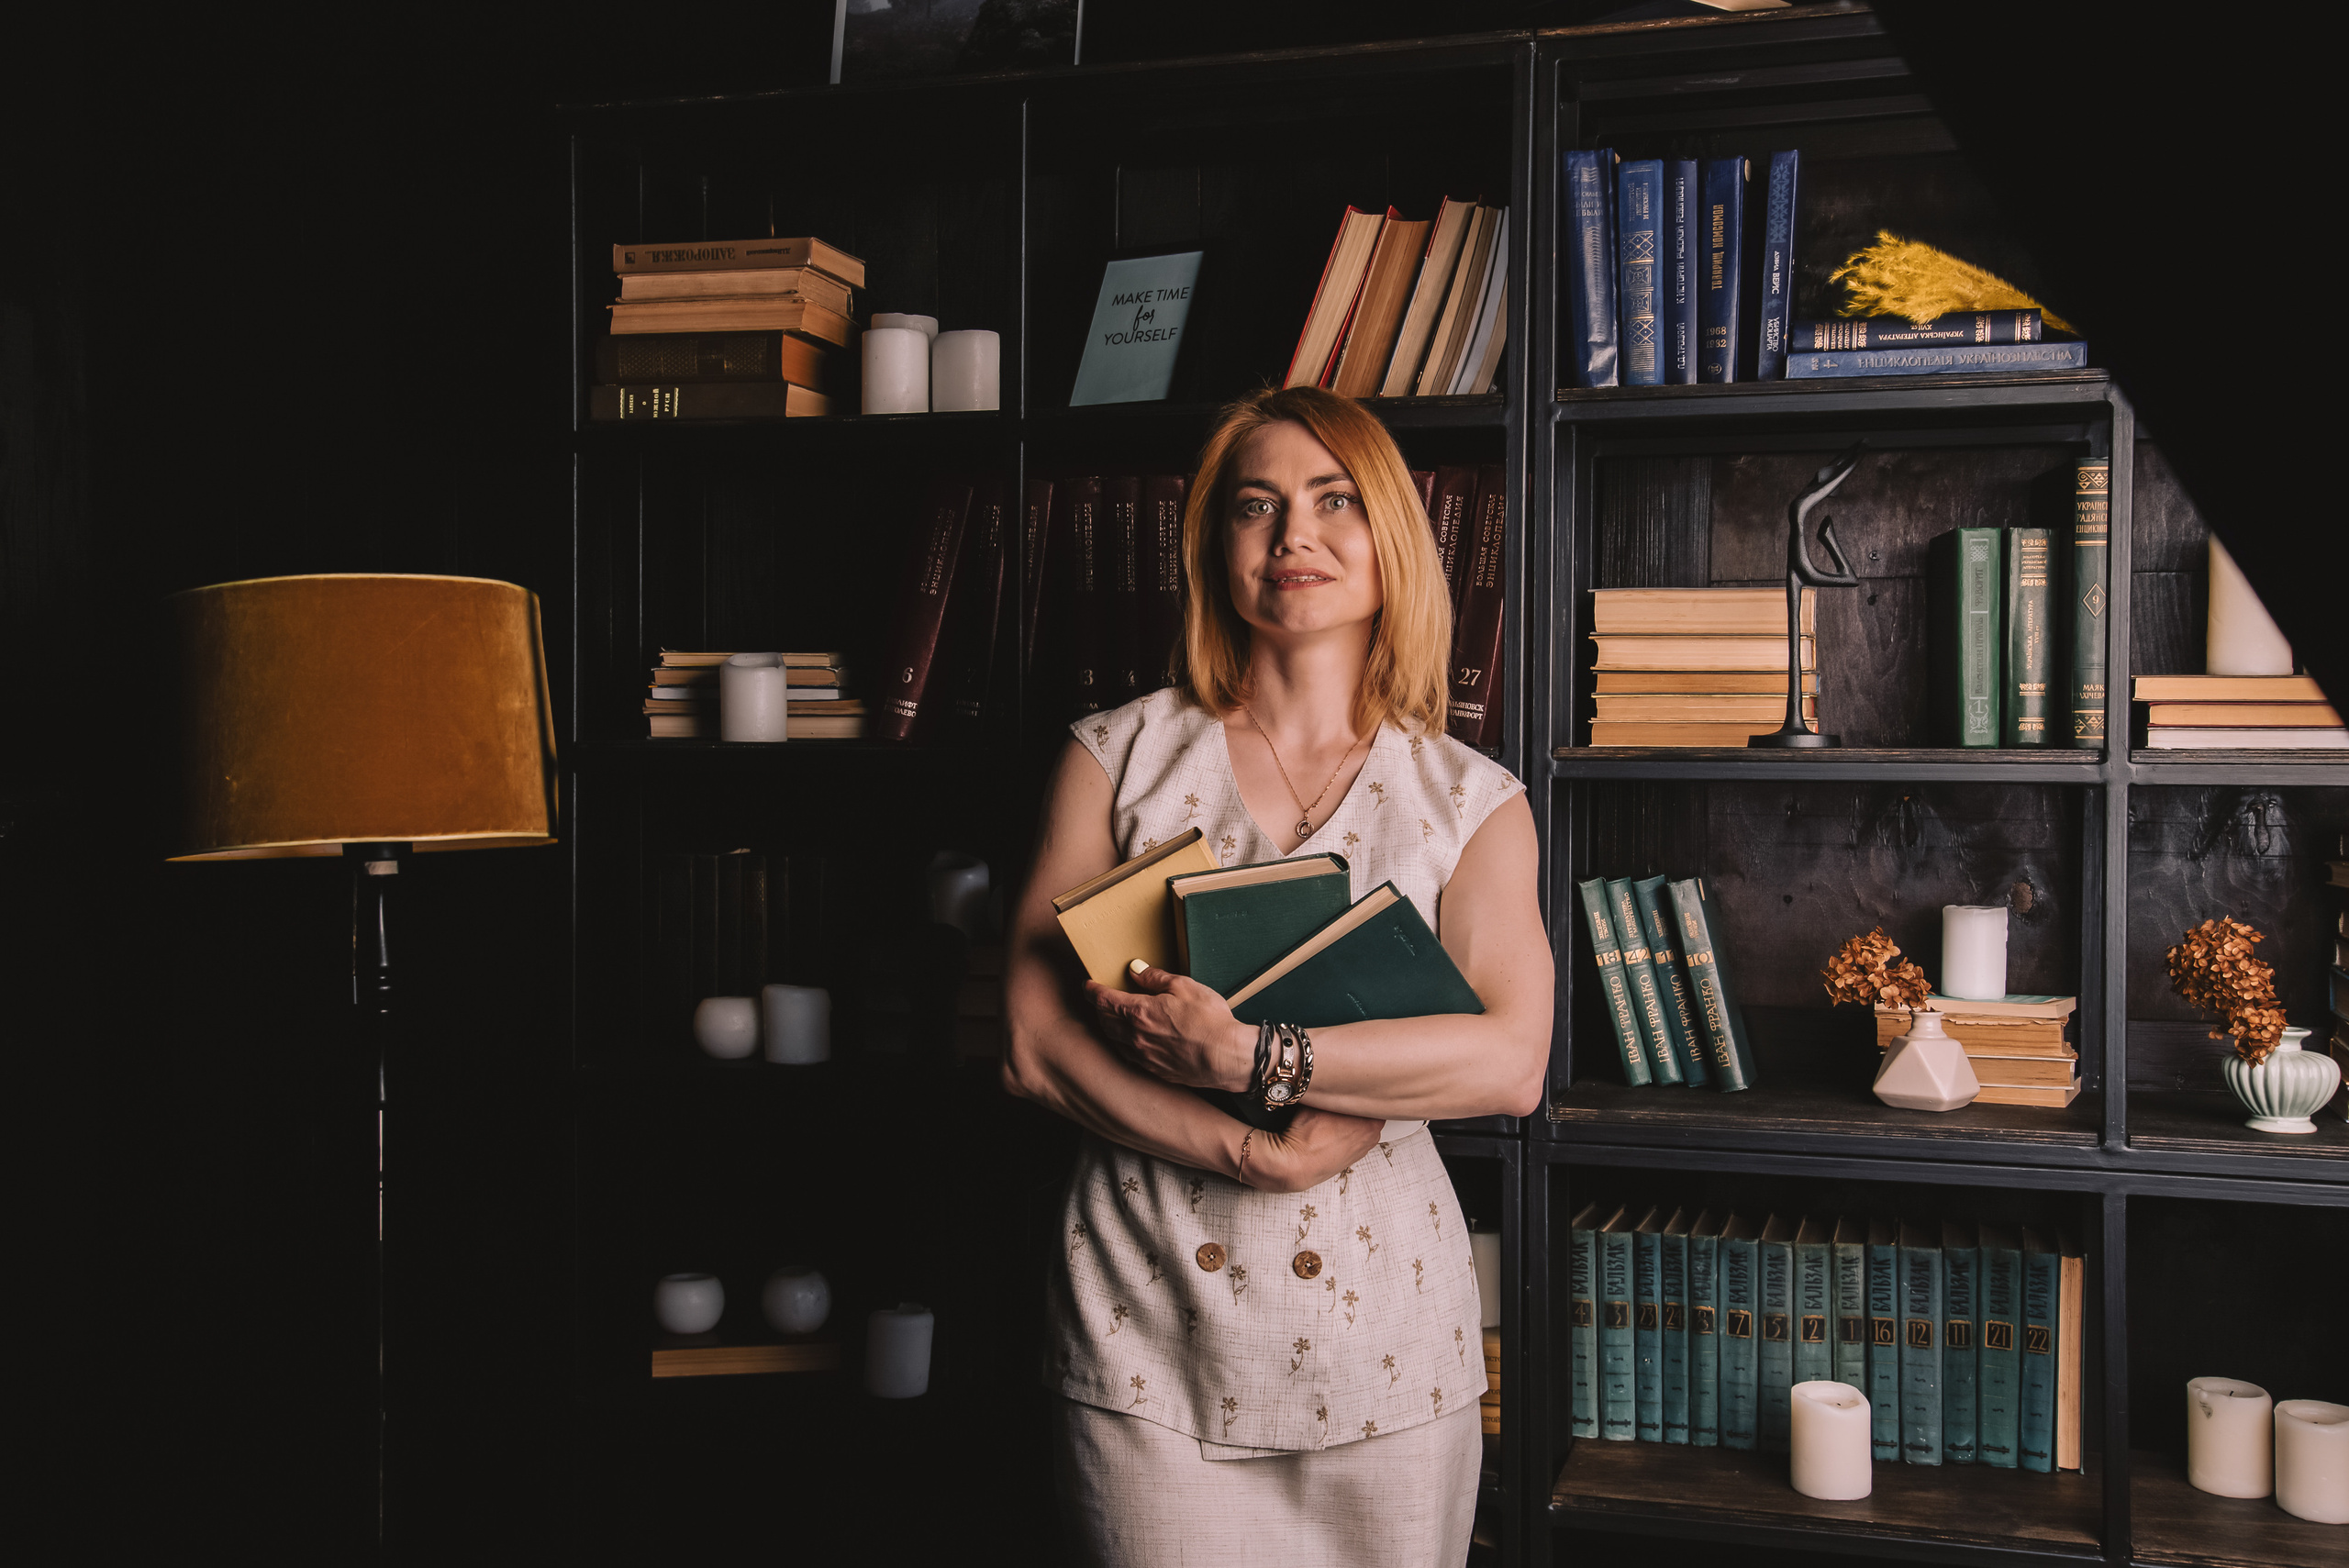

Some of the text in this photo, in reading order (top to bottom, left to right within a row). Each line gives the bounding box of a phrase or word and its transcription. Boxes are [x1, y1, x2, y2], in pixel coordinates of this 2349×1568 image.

[1675, 176, 1686, 223] РЕВОЛЮЦИИ
[1675, 226, 1686, 260] РУССКОЙ
[1710, 203, 1725, 291] ТОВАРИЩ КОМСОМОЛ
[1111, 286, 1190, 306] MAKE TIME
[1675, 261, 1686, 296] ИСТОРИИ
[1132, 305, 1156, 331] for
[1706, 326, 1727, 336] 1968
[1772, 317, 1780, 352] УБИЙСТВО
[1104, 327, 1178, 346] YOURSELF
[1823, 359, 1839, 369] 4
[1858, 350, 2074, 370] ЕНЦИКЛОПЕДІЯ УКРАЇНОЗНАВСТВА
[1439, 494, 1454, 544] СОВЕТСКАЯ
[929, 508, 956, 595] ЭНЦИКЛОПЕДИЯ
[1083, 502, 1094, 593] ЭНЦИКЛОПЕДИЯ
[1168, 499, 1178, 592] ЭНЦИКЛОПЕДИЯ
[1475, 493, 1497, 587] БОЛЬШАЯ СОВЕТСКАЯ
[1974, 567, 1984, 606] ФАВОРИТ
[2092, 594, 2099, 606] 9
[901, 666, 915, 684] 6
[1458, 666, 1482, 686] 27
[1450, 700, 1485, 712] ЛЬЯНОВСК
[1597, 950, 1619, 966] 18
[1627, 948, 1650, 963] 42
[1657, 950, 1675, 964] 11
[1687, 951, 1712, 967] 10
[1609, 975, 1642, 1065] ІВАН ФРАНКО
[1639, 973, 1671, 1063] ІВАН ФРАНКО
[1669, 973, 1703, 1064] ІВАН ФРАНКО
[1699, 978, 1731, 1069] ІВАН ФРАНКО
[1571, 1241, 1588, 1295] БАЛЬЗАК
[1607, 1242, 1625, 1296] БАЛЬЗАК
[1637, 1245, 1654, 1296] БАЛЬЗАК
[1665, 1245, 1684, 1297] БАЛЬЗАК
[1693, 1248, 1712, 1301] БАЛЬЗАК
[1729, 1249, 1748, 1304] БАЛЬЗАК
[1766, 1253, 1787, 1307] БАЛЬЗАК
[1804, 1255, 1823, 1309] БАЛЬЗАК
[1841, 1256, 1860, 1310] БАЛЬЗАК
[1872, 1257, 1891, 1313] БАЛЬЗАК
[1909, 1258, 1931, 1315] БАЛЬЗАК
[1950, 1261, 1970, 1316] БАЛЬЗАК
[1990, 1260, 2011, 1316] БАЛЬЗАК
[2028, 1262, 2049, 1320] БАЛЬЗАК
[1615, 1305, 1622, 1326] 3
[1640, 1307, 1654, 1327] 23
[1697, 1309, 1709, 1331] 8
[1734, 1315, 1745, 1335] 7
[1772, 1318, 1783, 1338] 5
[1809, 1318, 1819, 1340] 2
[1848, 1319, 1854, 1340] 1
[1873, 1320, 1891, 1342] 16
[1911, 1322, 1928, 1345] 12
[1953, 1324, 1965, 1345] 11
[1991, 1324, 2007, 1346] 21
[2029, 1329, 2048, 1351] 22
